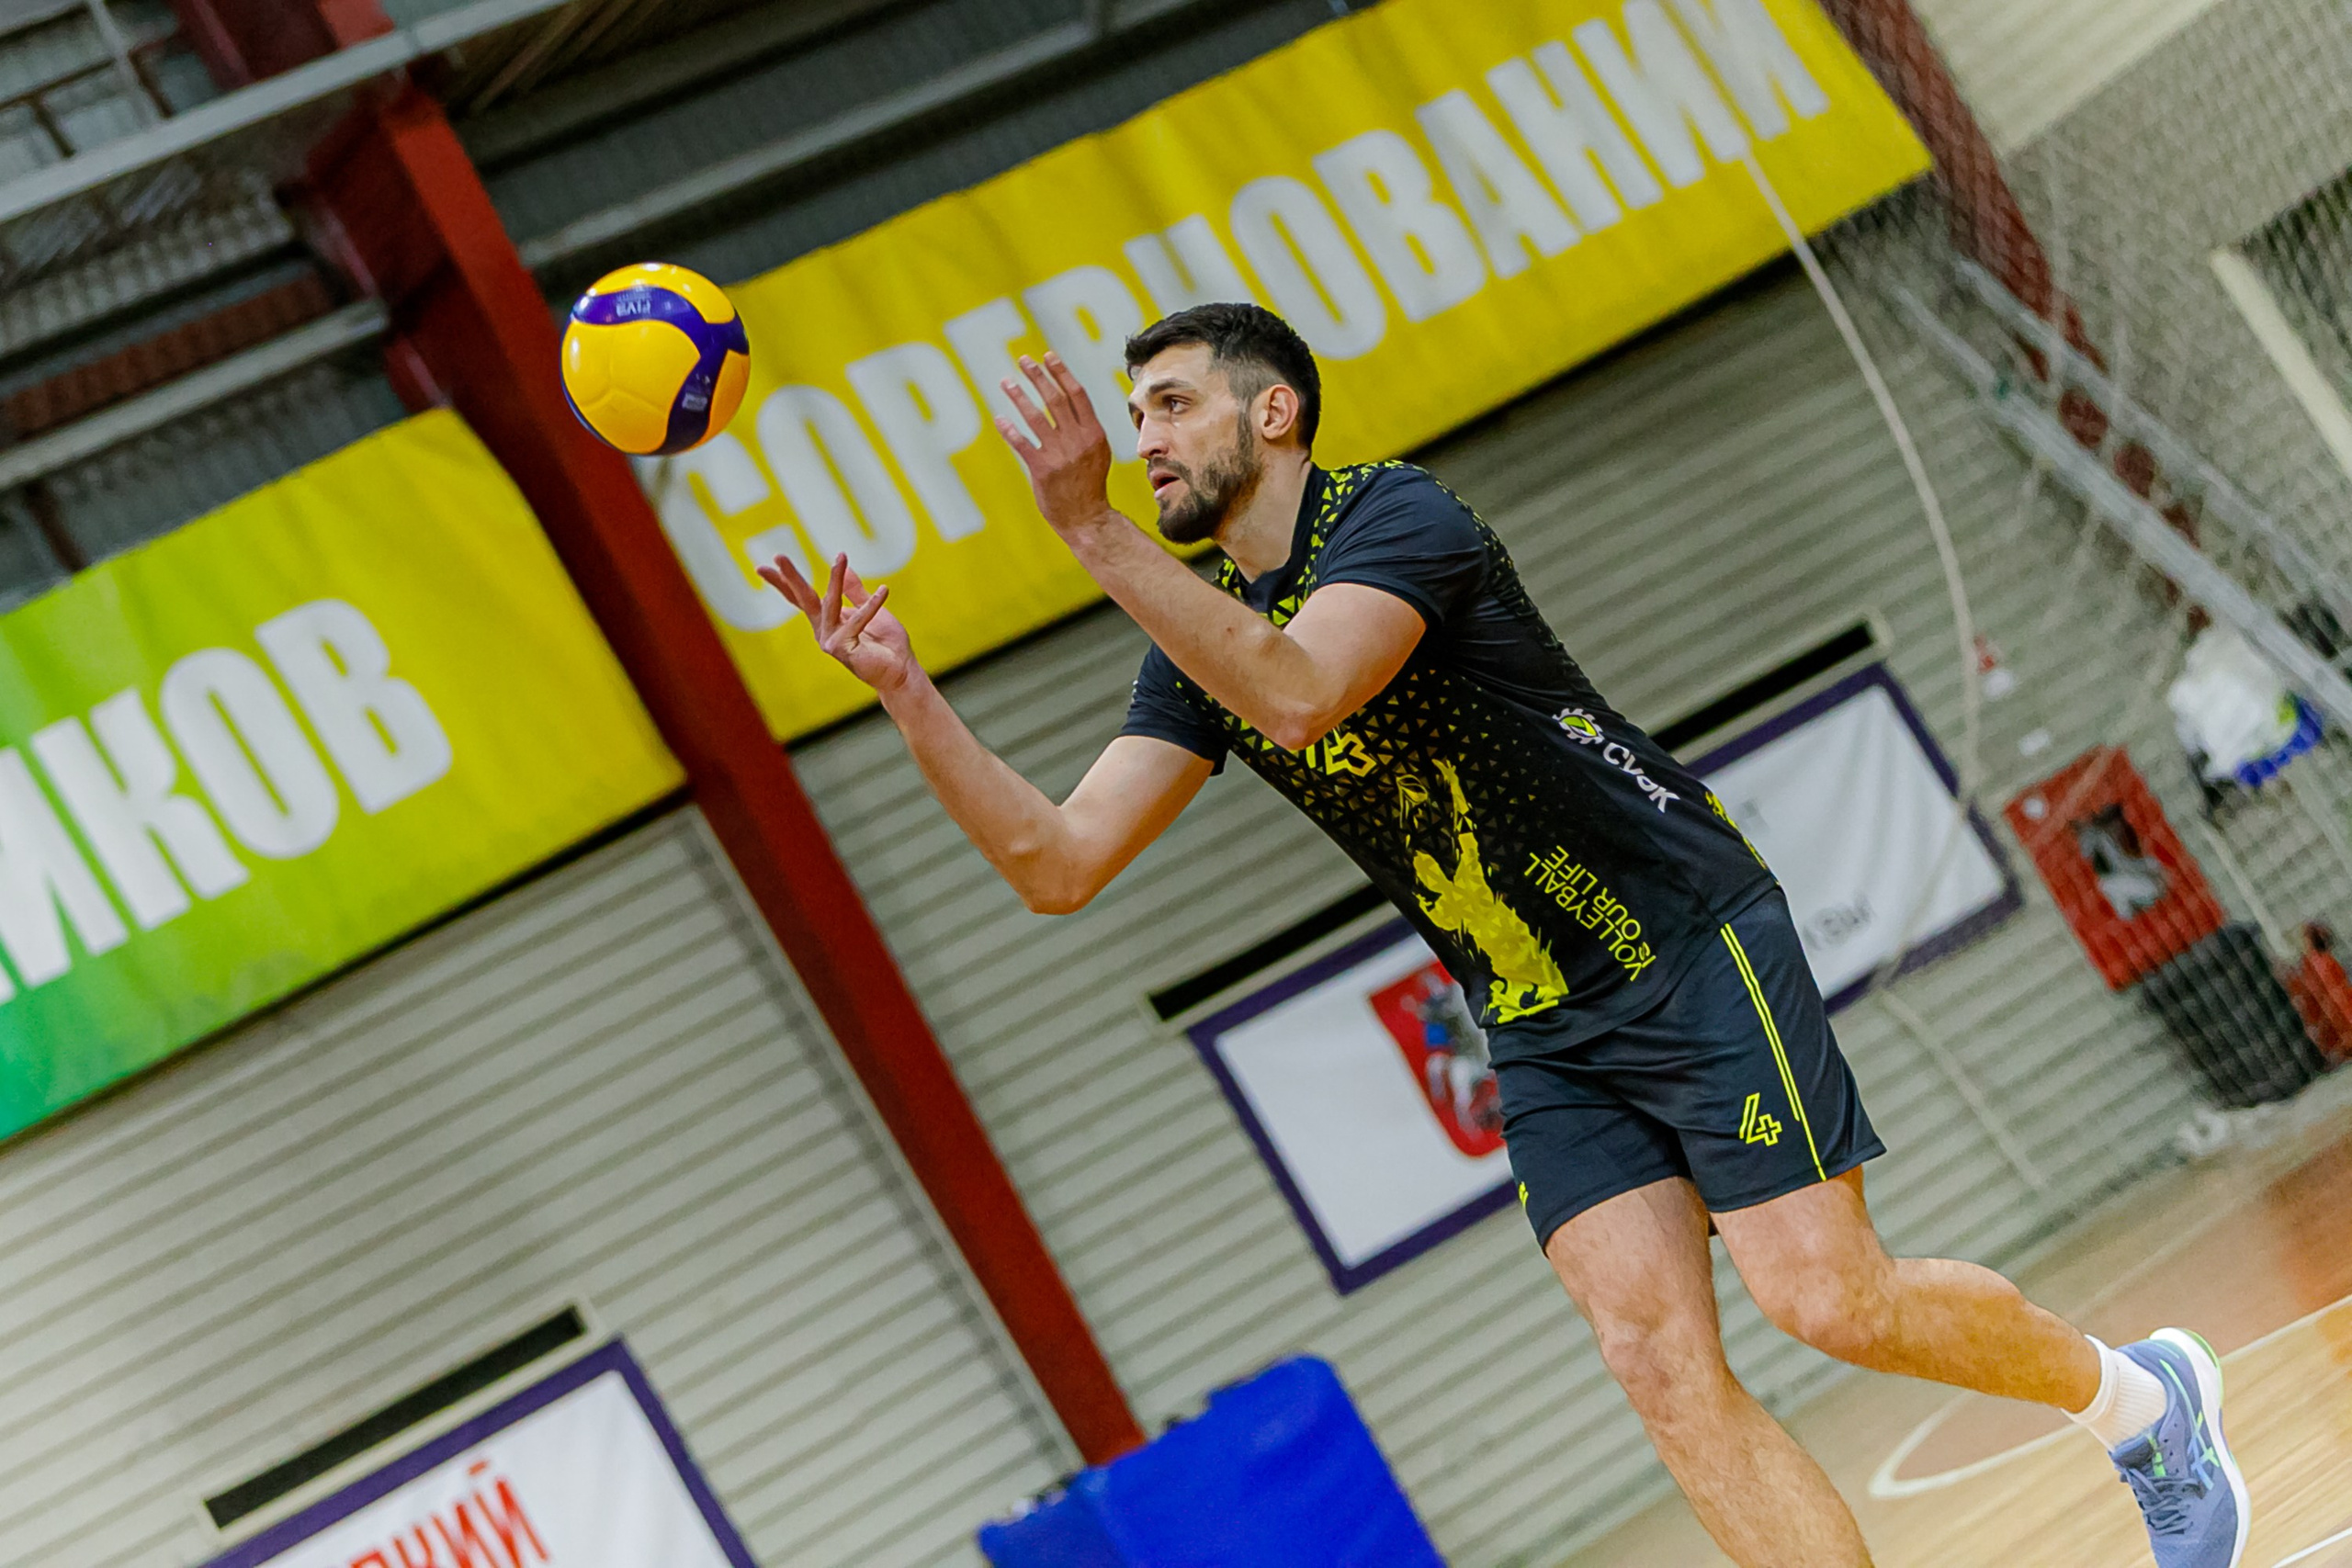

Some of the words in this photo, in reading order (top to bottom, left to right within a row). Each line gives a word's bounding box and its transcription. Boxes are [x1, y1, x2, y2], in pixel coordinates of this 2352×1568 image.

[0, 598, 453, 1007] ИКОВ
[1544, 844, 1599, 896] LIFE
[1523, 852, 1643, 982] VOLLEYBALL
[1592, 886, 1642, 941] OUR
[1739, 1091, 1782, 1146] 4
